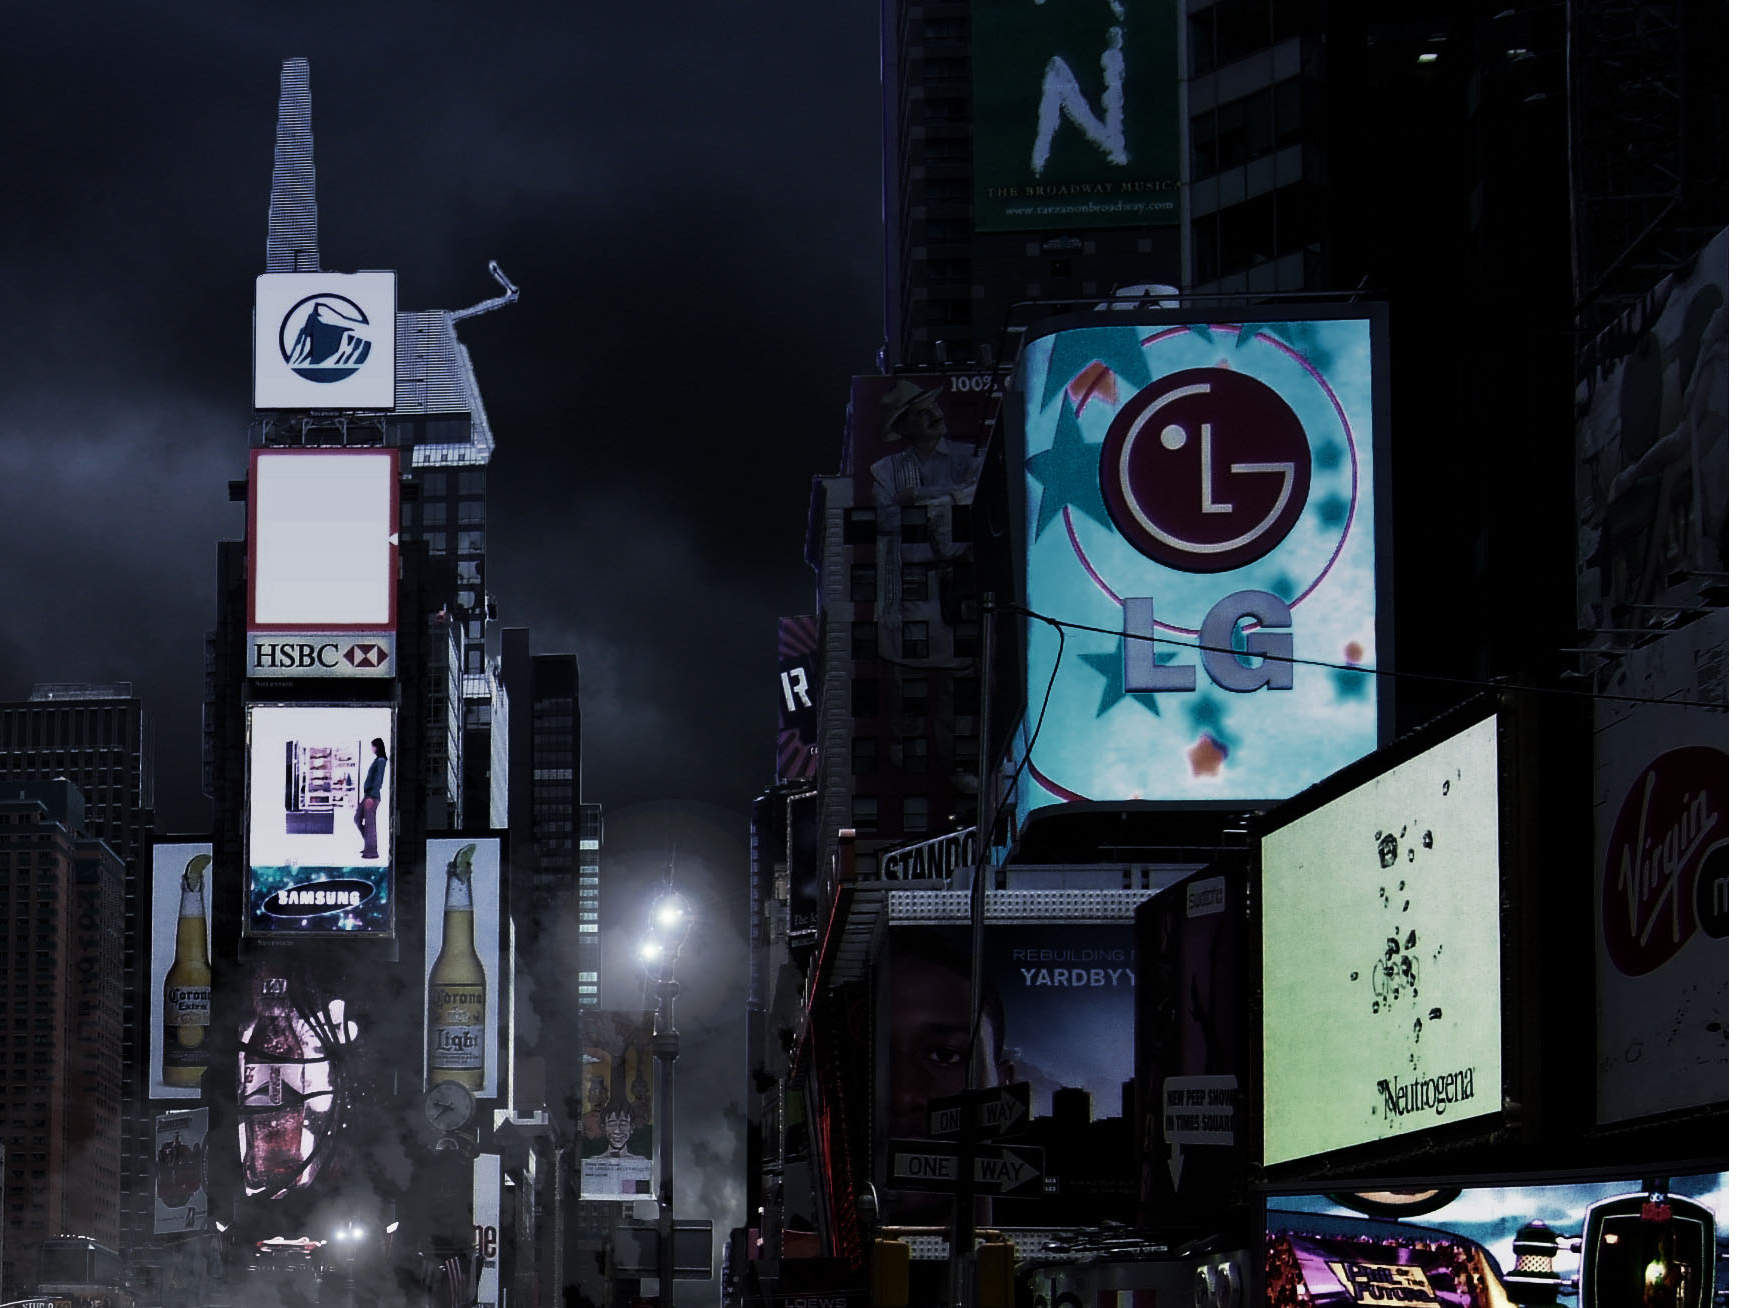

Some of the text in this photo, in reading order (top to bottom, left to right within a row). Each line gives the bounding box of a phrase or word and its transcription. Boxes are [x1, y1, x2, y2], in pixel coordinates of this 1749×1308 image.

[1026, 183, 1114, 197] BROADWAY
[1123, 590, 1294, 693] LG
[253, 642, 339, 668] HSBC
[277, 890, 361, 908] SAMSUNG
[1012, 949, 1124, 961] REBUILDING
[1167, 1089, 1183, 1107] NEW
[1186, 1089, 1206, 1106] PEEP
[1383, 1066, 1476, 1119] Neutrogena
[1176, 1113, 1200, 1131] TIMES
[908, 1156, 1024, 1182] ONE WAY
